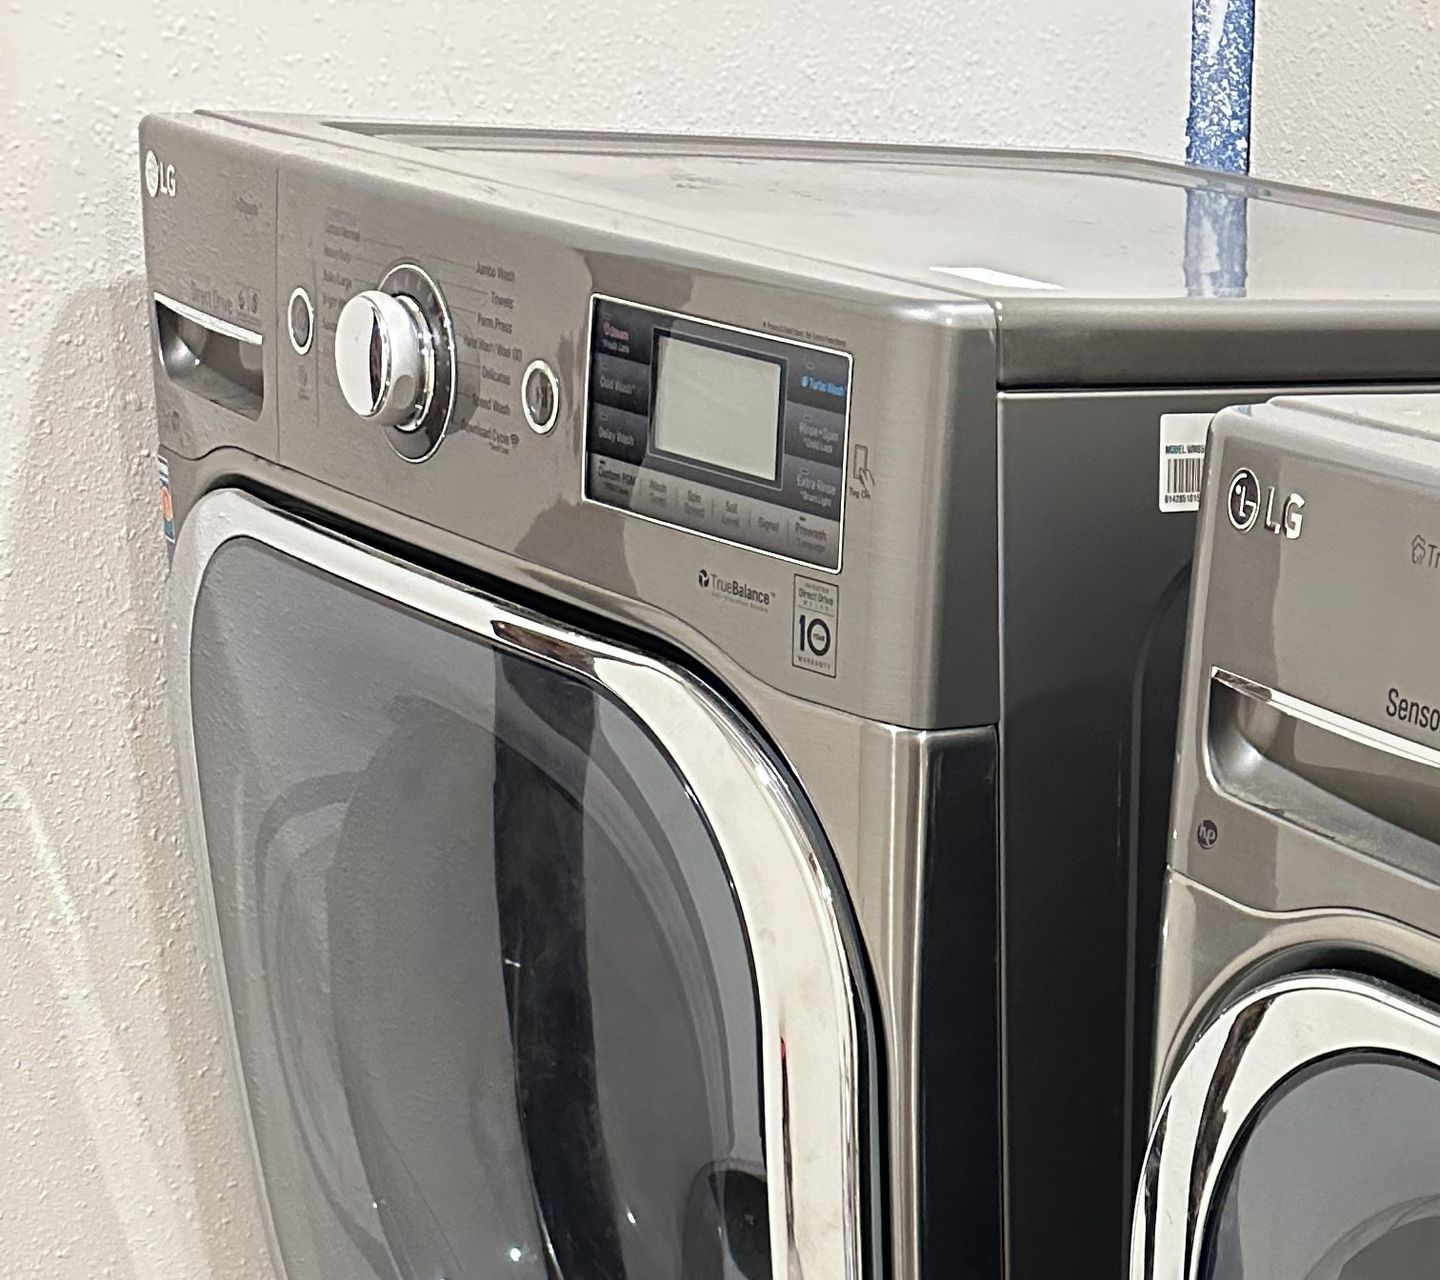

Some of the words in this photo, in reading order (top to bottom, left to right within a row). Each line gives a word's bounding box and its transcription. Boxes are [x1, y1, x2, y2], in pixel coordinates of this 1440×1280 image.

[159, 161, 176, 197] LG
[1265, 485, 1305, 539] LG
[799, 614, 831, 656] 10
